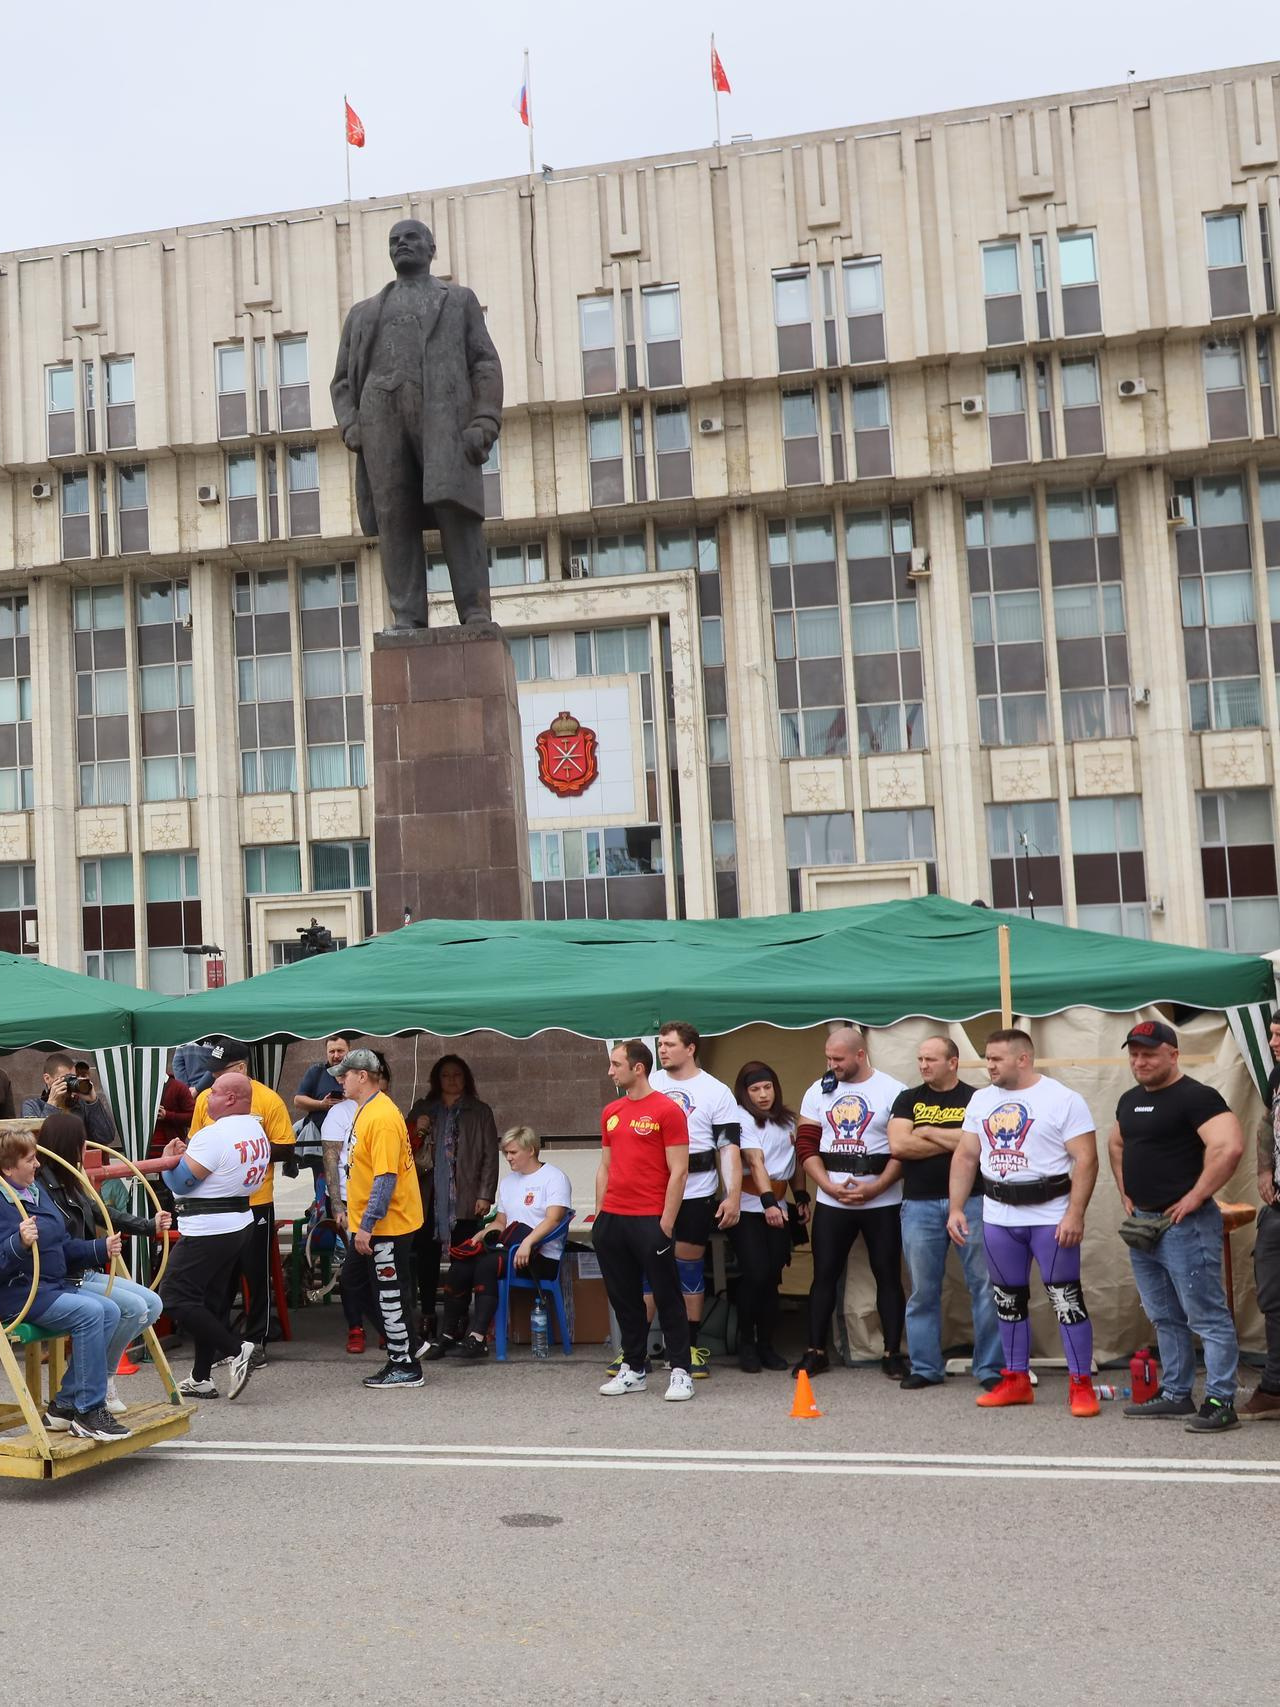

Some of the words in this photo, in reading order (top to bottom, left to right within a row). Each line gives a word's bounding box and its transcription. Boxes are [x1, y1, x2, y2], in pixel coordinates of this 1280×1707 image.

[234, 1136, 269, 1164] ТУЛ
[242, 1163, 269, 1188] 87
[373, 1241, 398, 1282] NO
